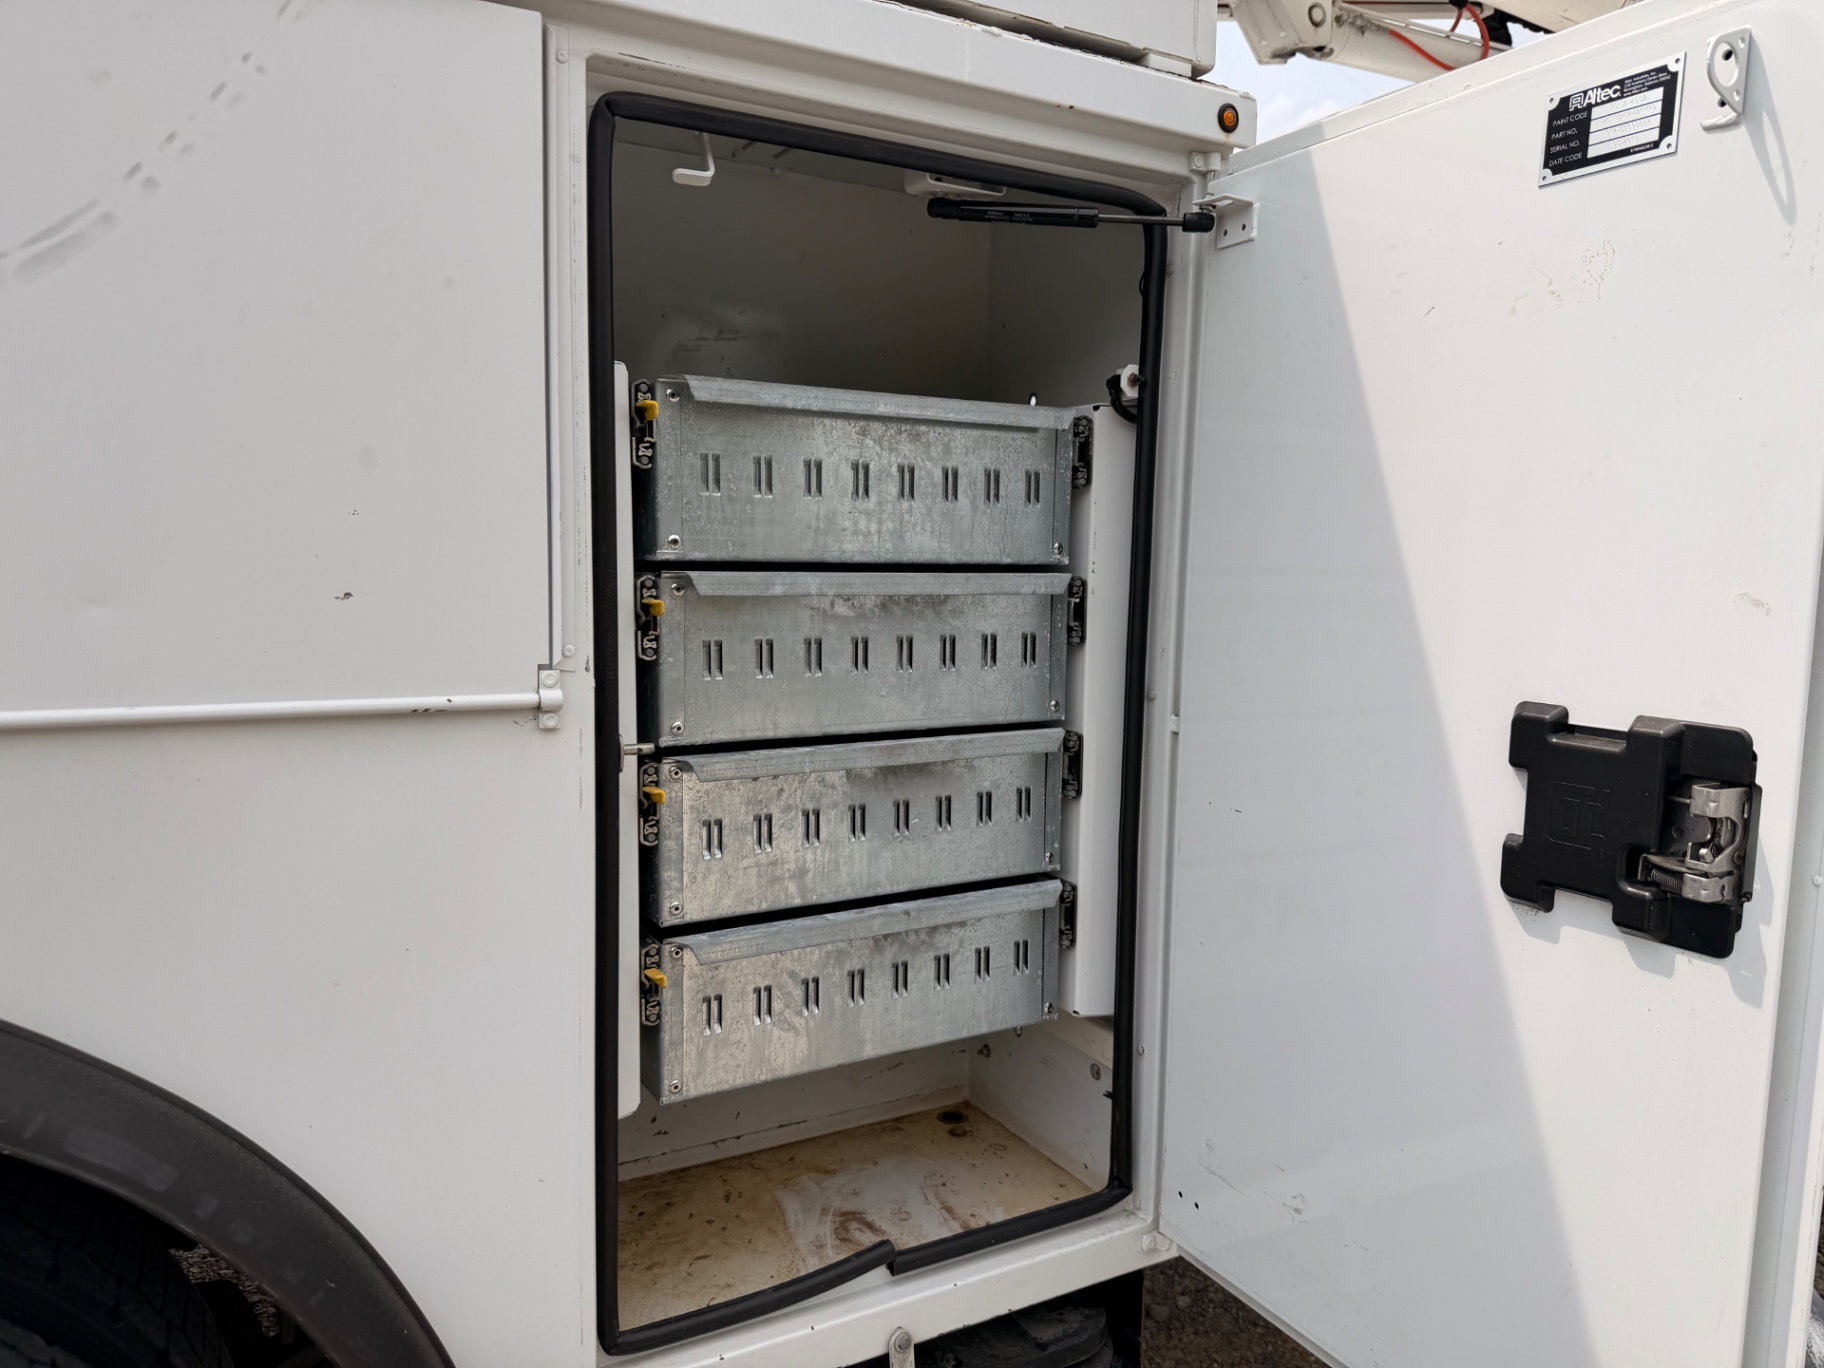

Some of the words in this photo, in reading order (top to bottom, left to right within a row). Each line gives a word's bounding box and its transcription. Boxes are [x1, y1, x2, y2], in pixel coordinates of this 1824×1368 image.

[1583, 85, 1620, 107] Altec
[1552, 116, 1569, 127] PAINT
[1569, 111, 1588, 122] CODE
[1551, 130, 1566, 140] PART
[1566, 127, 1578, 136] NO.
[1549, 144, 1568, 154] SERIAL
[1568, 139, 1580, 148] NO.
[1548, 157, 1563, 167] DATE
[1564, 152, 1583, 163] CODE
